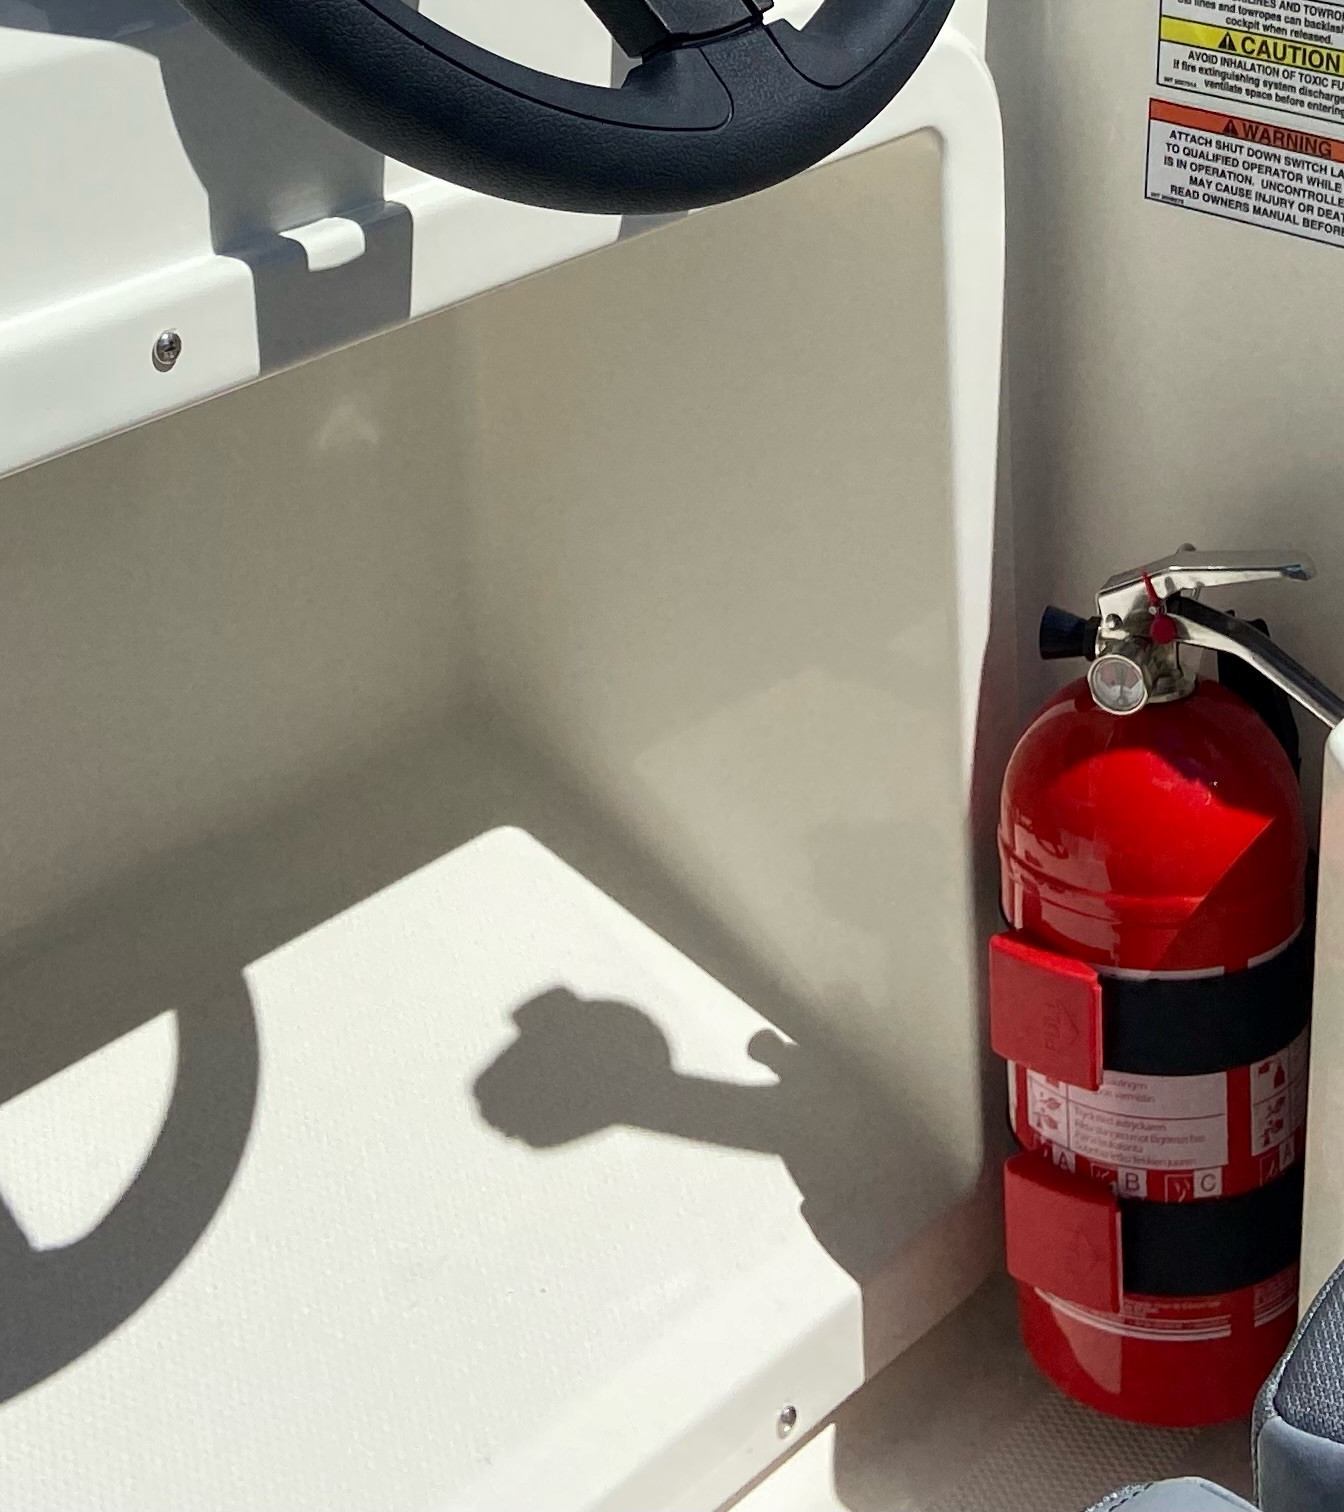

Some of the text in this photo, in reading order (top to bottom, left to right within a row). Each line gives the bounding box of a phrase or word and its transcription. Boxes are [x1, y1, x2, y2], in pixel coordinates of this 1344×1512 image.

[1278, 0, 1301, 13] AND
[1187, 50, 1218, 65] AVOID
[1219, 56, 1280, 78] INHALATION
[1281, 69, 1296, 81] OF
[1297, 72, 1329, 88] TOXIC
[1240, 35, 1341, 73] CAUTION
[1169, 129, 1213, 148] ATTACH
[1215, 139, 1245, 155] SHUT
[1246, 146, 1281, 164] DOWN
[1283, 155, 1328, 175] SWITCH
[1242, 122, 1332, 158] WARNING
[1163, 155, 1174, 167] IS
[1176, 158, 1187, 170] IN
[1165, 141, 1180, 154] TO
[1182, 146, 1240, 168] QUALIFIED
[1241, 159, 1303, 184] OPERATOR
[1305, 175, 1342, 194] WHILE
[1170, 184, 1200, 200] READ
[1201, 192, 1250, 213] OWNERS
[1252, 204, 1299, 226] MANUAL
[1188, 175, 1213, 190] MAY
[1214, 181, 1252, 200] CAUSE
[1254, 191, 1295, 210] INJURY
[1297, 201, 1314, 215] OR
[1125, 1172, 1141, 1192] B
[1200, 1173, 1217, 1193] C
